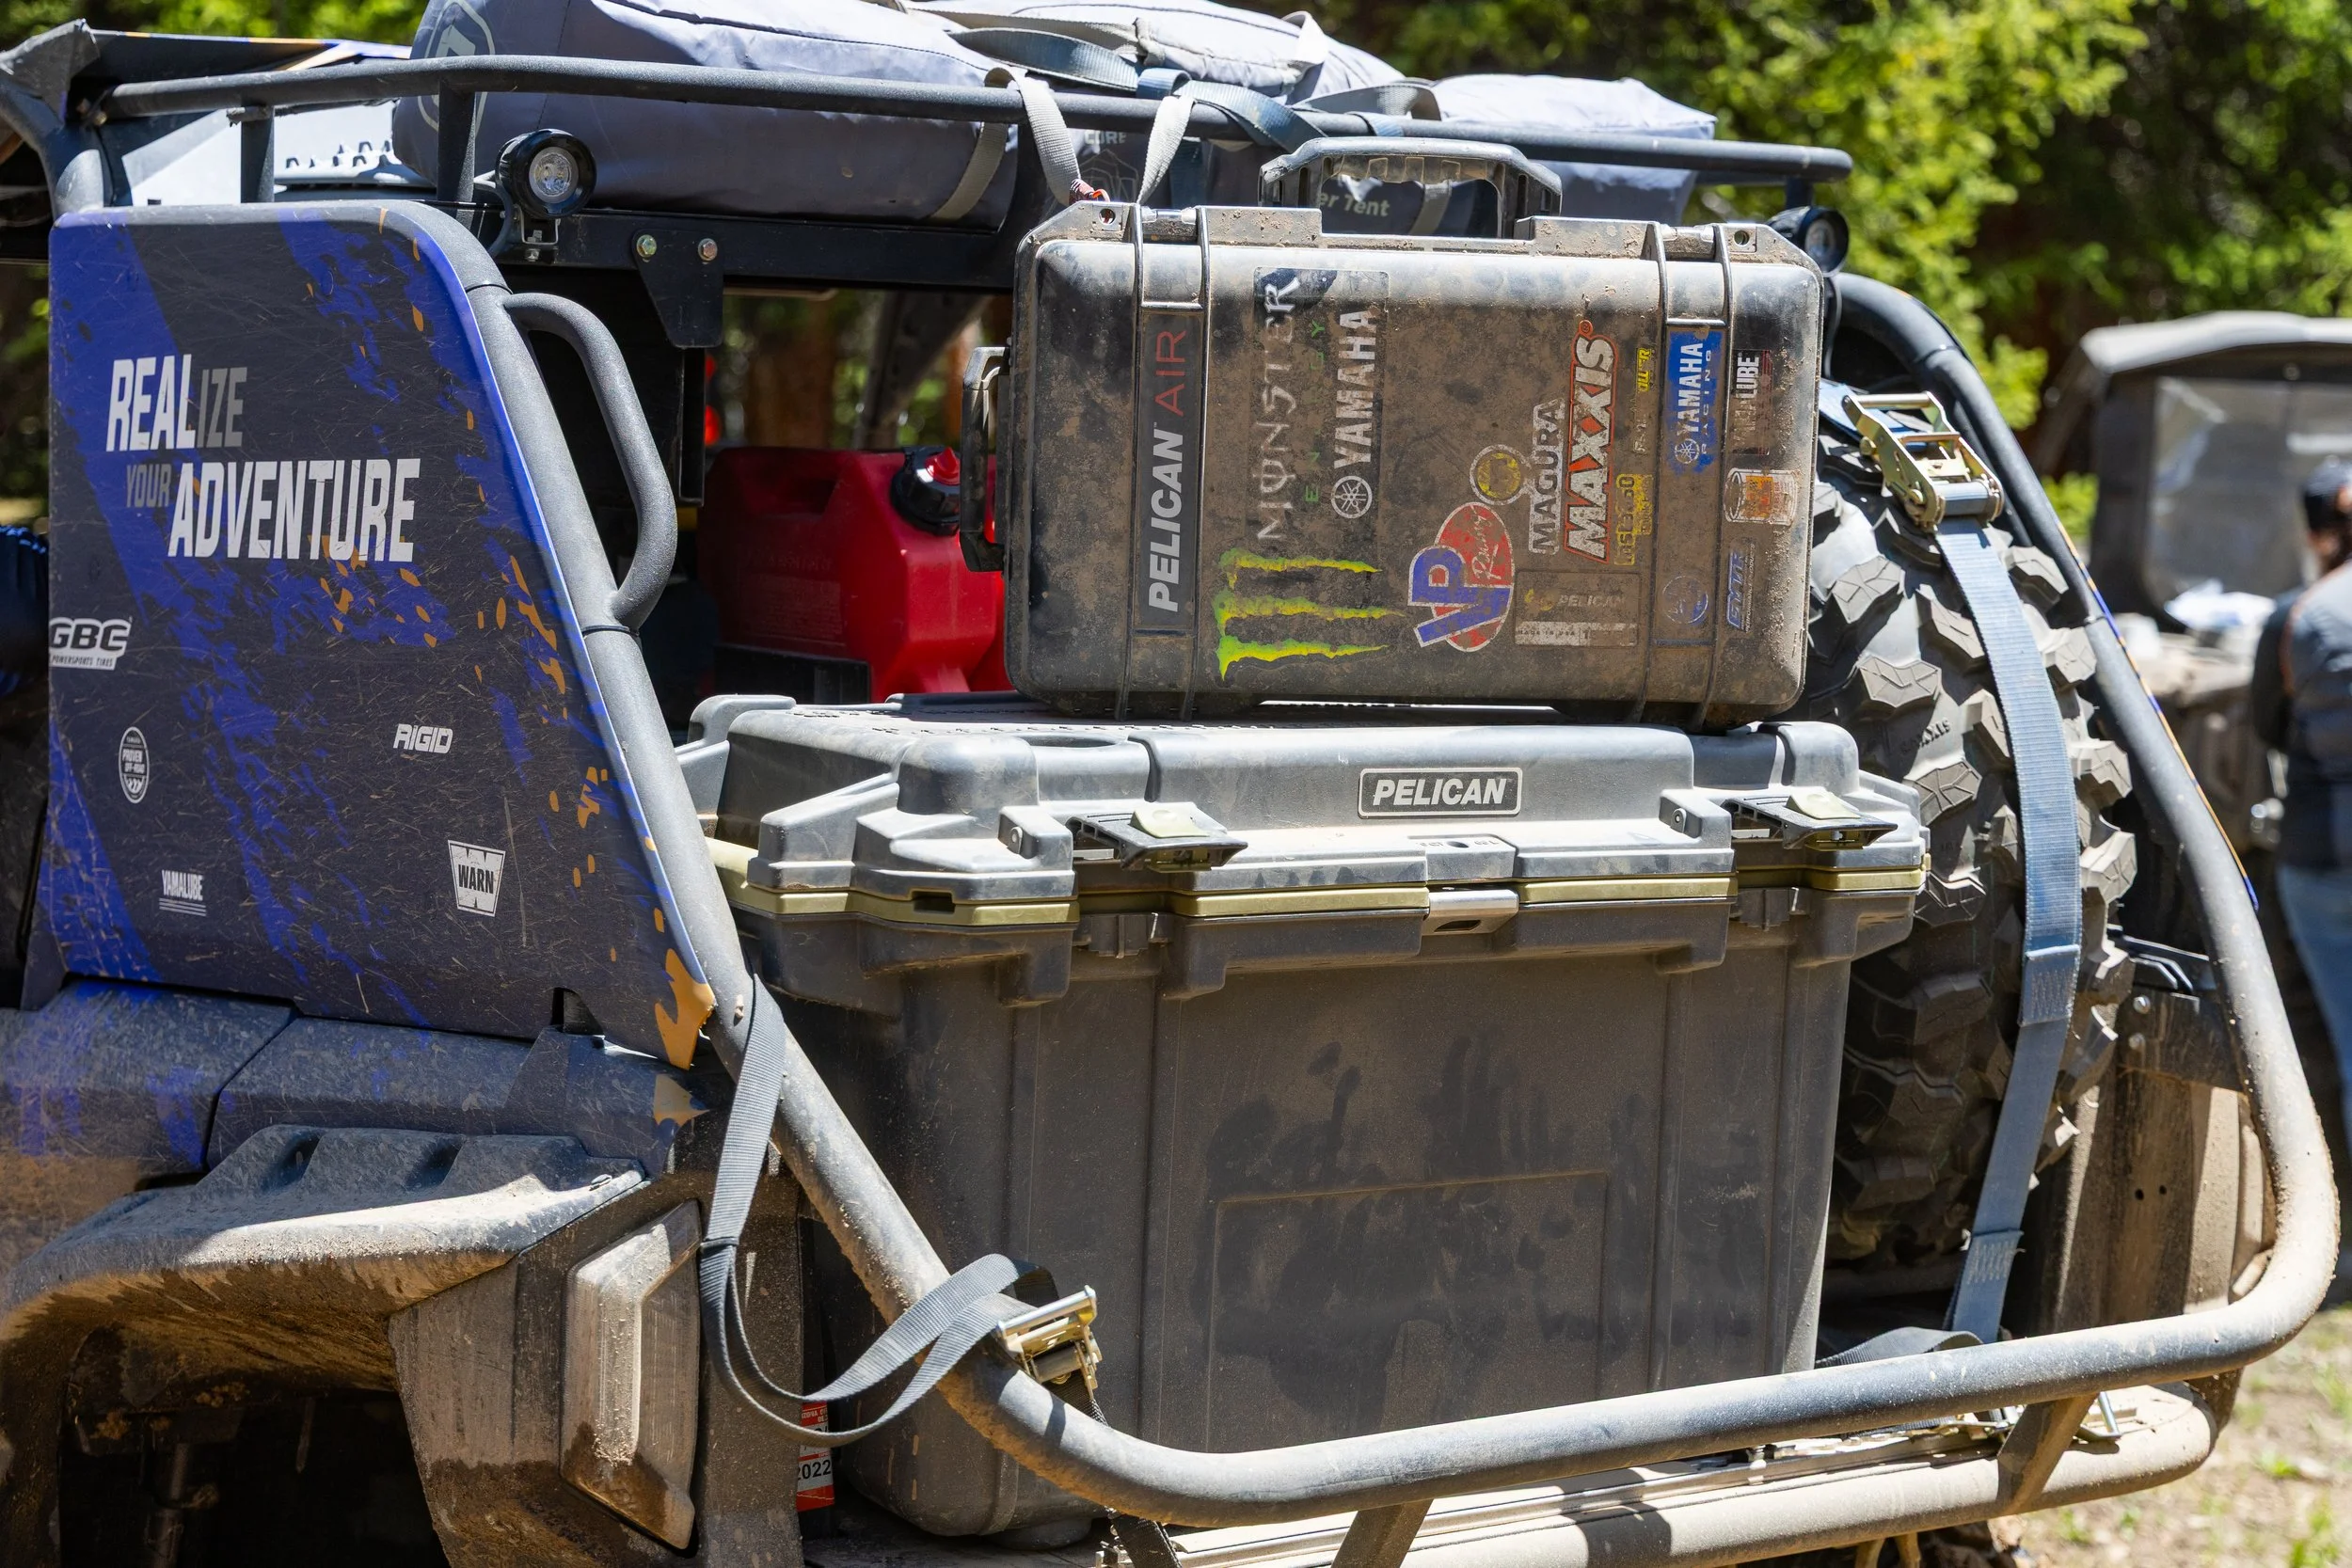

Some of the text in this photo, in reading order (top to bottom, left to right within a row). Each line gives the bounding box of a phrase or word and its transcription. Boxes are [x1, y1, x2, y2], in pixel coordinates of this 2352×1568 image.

[1344, 194, 1391, 217] Tent
[106, 354, 247, 451] REALIZE
[1334, 310, 1377, 468] YAMAHA
[1677, 342, 1704, 436] YAMAHA
[1149, 331, 1186, 613] PELICAN AIR
[1533, 402, 1565, 553] MAGURA
[1567, 336, 1614, 560] MAXXIS
[126, 458, 421, 562] YOUR ADVENTURE
[50, 622, 128, 651] GBC
[1373, 778, 1507, 806] PELICAN
[162, 869, 204, 901] YAMALUBE
[458, 863, 494, 894] WARN
